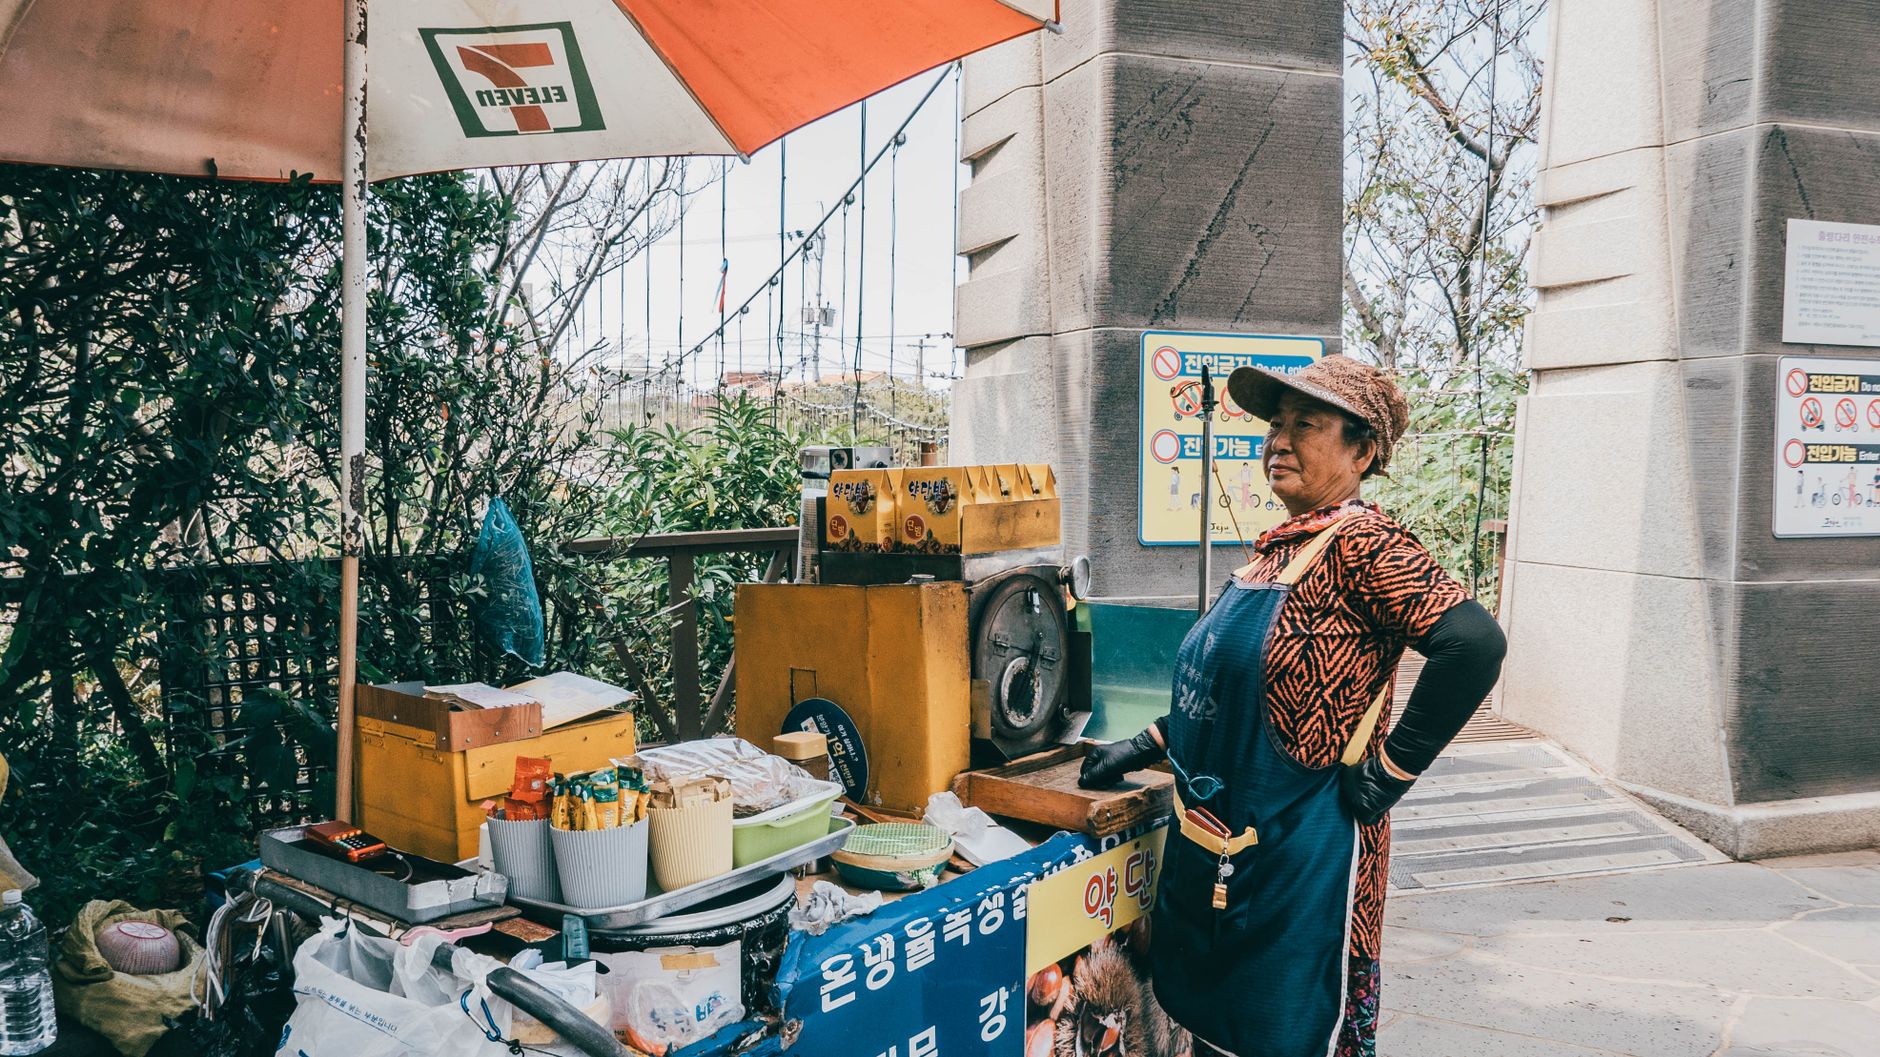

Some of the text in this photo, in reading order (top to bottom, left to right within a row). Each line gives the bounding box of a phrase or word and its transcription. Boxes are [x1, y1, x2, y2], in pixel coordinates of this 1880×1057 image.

[1809, 374, 1860, 393] 진입금지
[1861, 381, 1872, 392] Do
[1807, 445, 1857, 462] 진입가능
[1859, 450, 1879, 461] Enter
[908, 480, 946, 502] 약단밤
